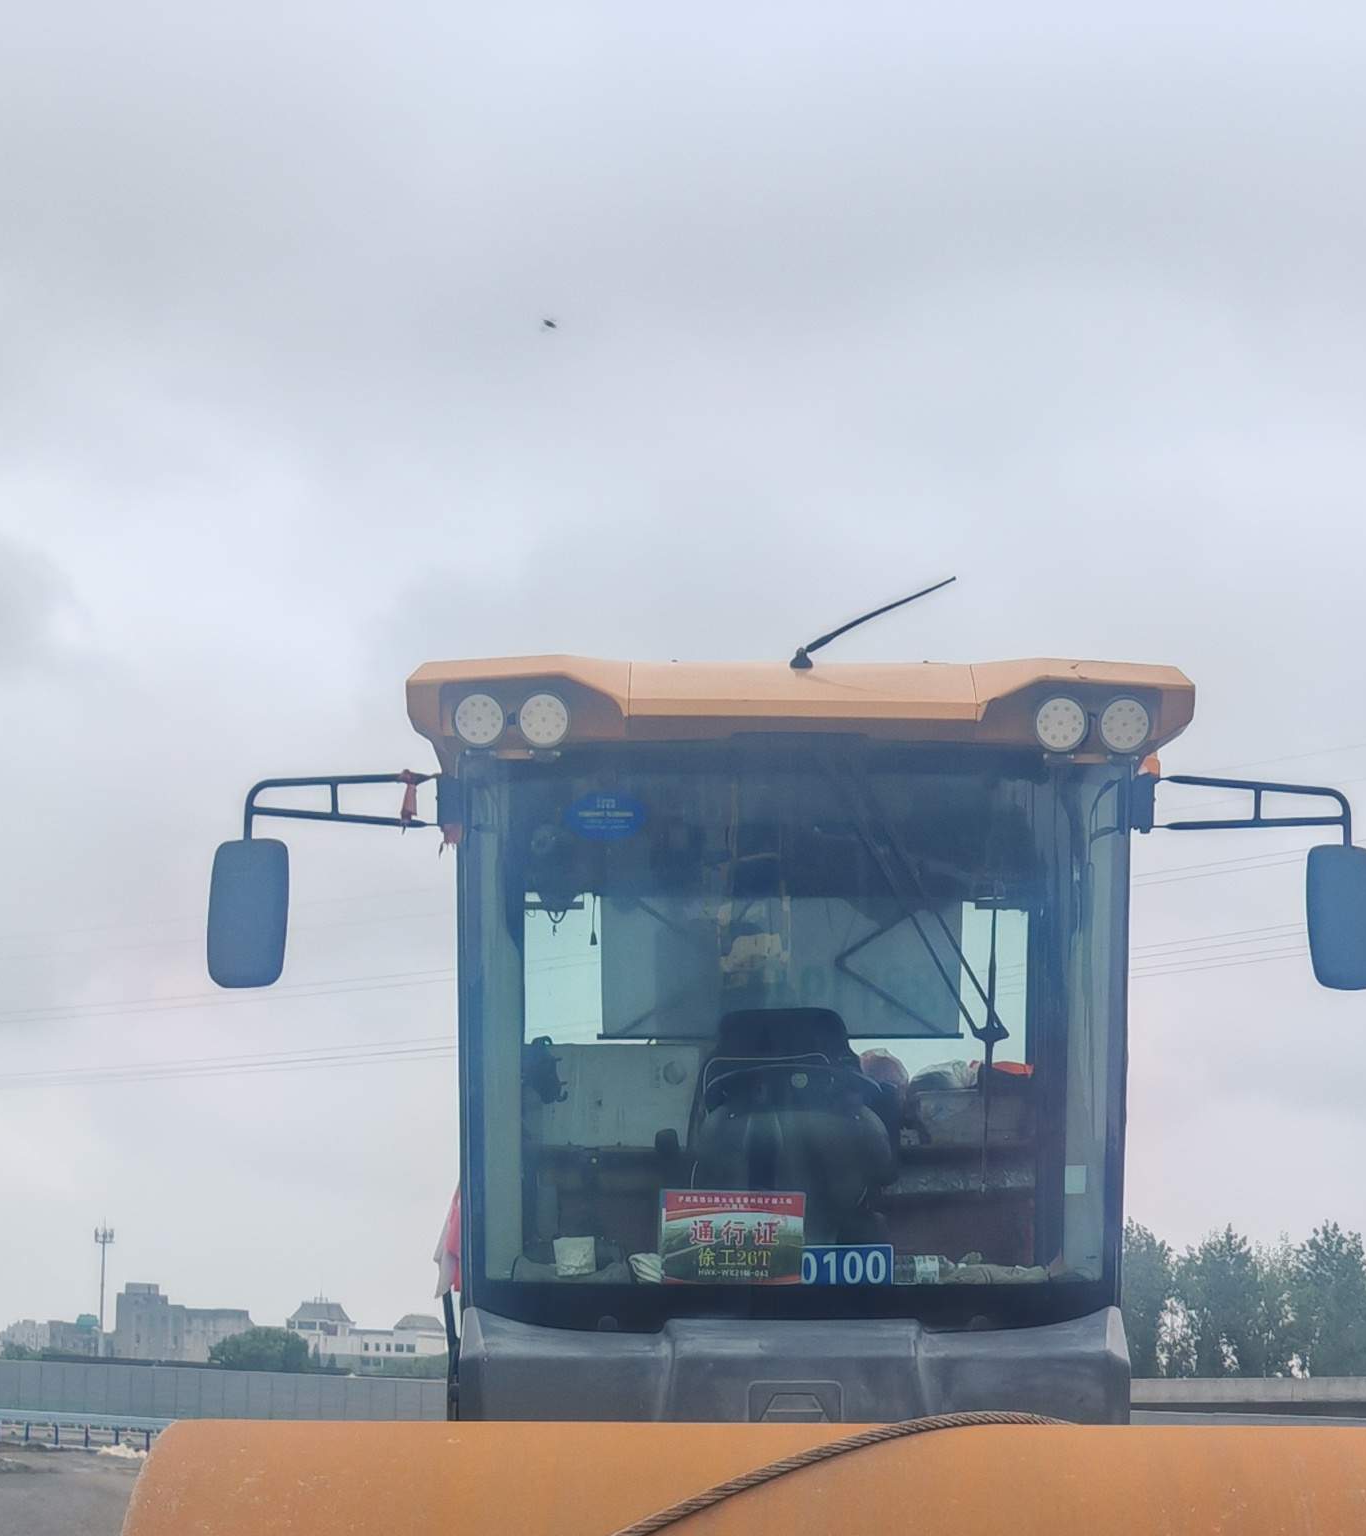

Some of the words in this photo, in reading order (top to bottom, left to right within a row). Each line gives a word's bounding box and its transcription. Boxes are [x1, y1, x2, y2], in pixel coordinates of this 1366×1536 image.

[690, 1220, 780, 1246] 通行证
[698, 1247, 771, 1267] 徐工26T
